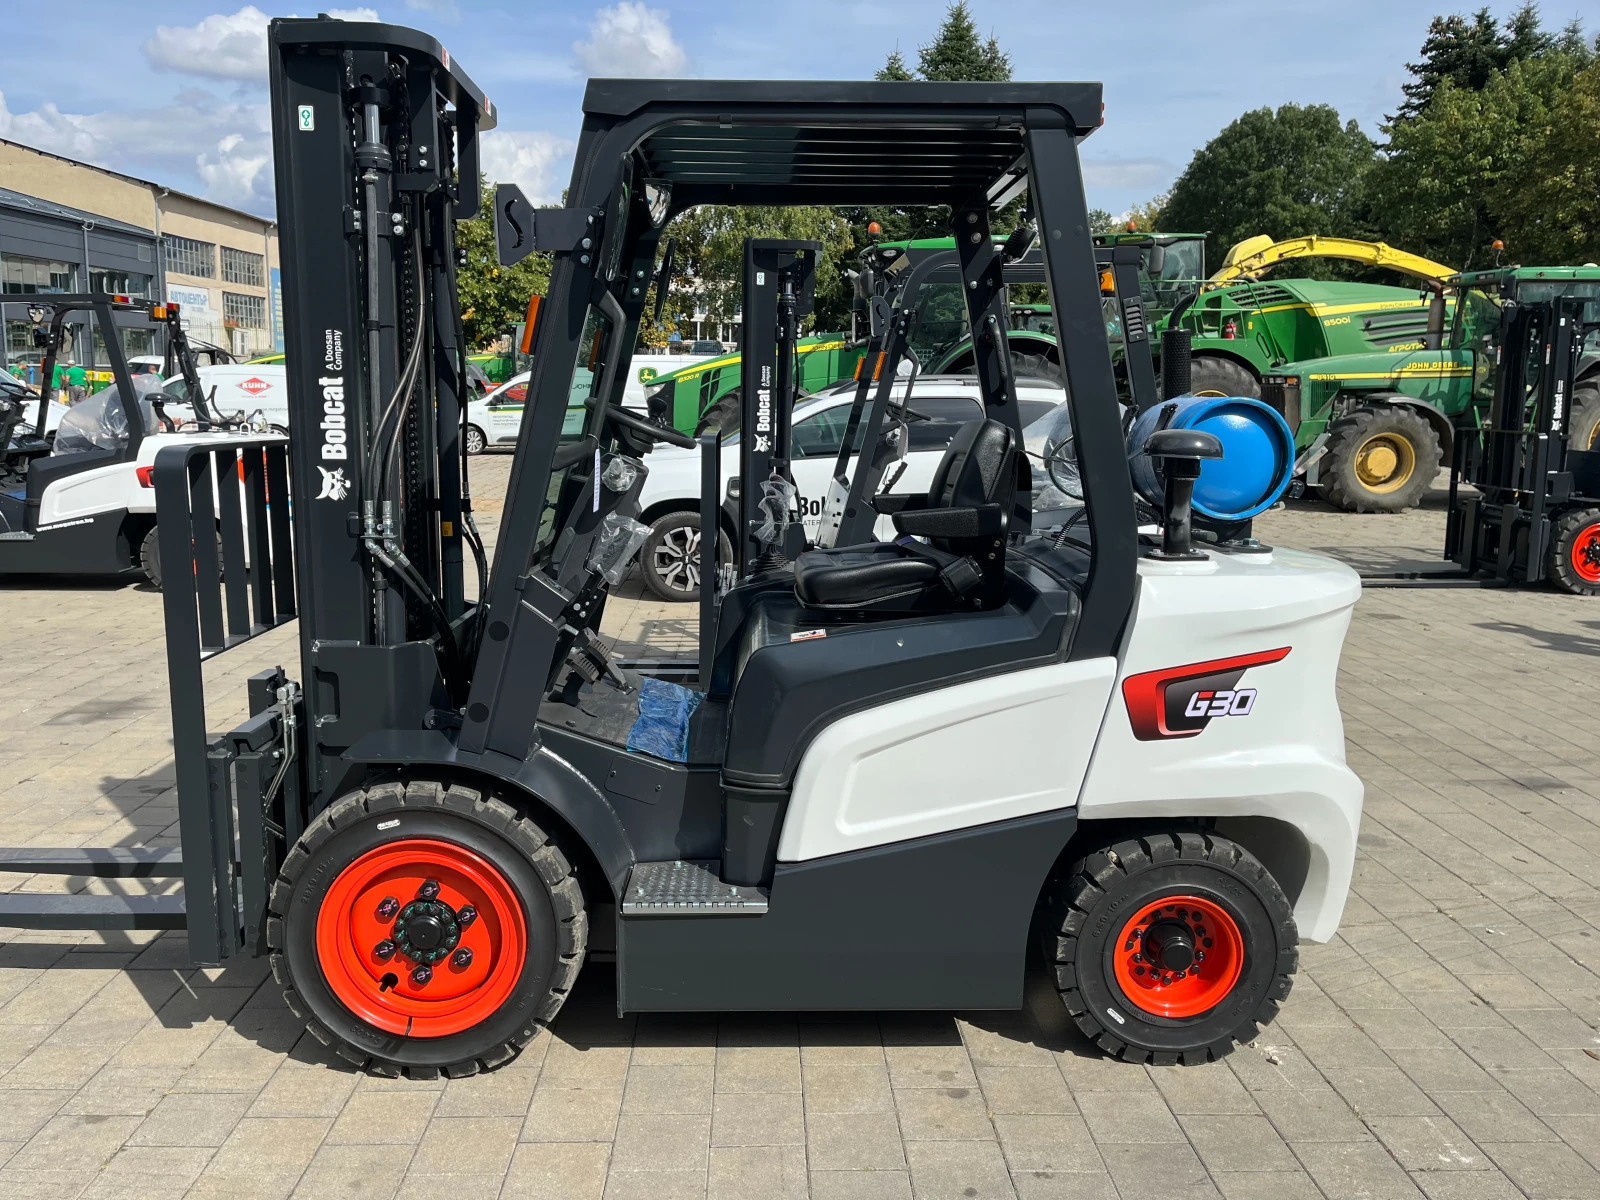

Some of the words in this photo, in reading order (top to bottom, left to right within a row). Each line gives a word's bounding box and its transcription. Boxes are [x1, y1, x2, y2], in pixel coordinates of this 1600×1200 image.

[1323, 316, 1351, 327] 8500i
[324, 329, 334, 361] Doosan
[333, 329, 344, 371] Company
[325, 363, 334, 371] A
[1406, 362, 1430, 370] JOHN
[1432, 361, 1459, 369] DEERE
[319, 377, 347, 460] Bobcat
[757, 389, 771, 432] Bobcat
[1184, 688, 1257, 718] G30
